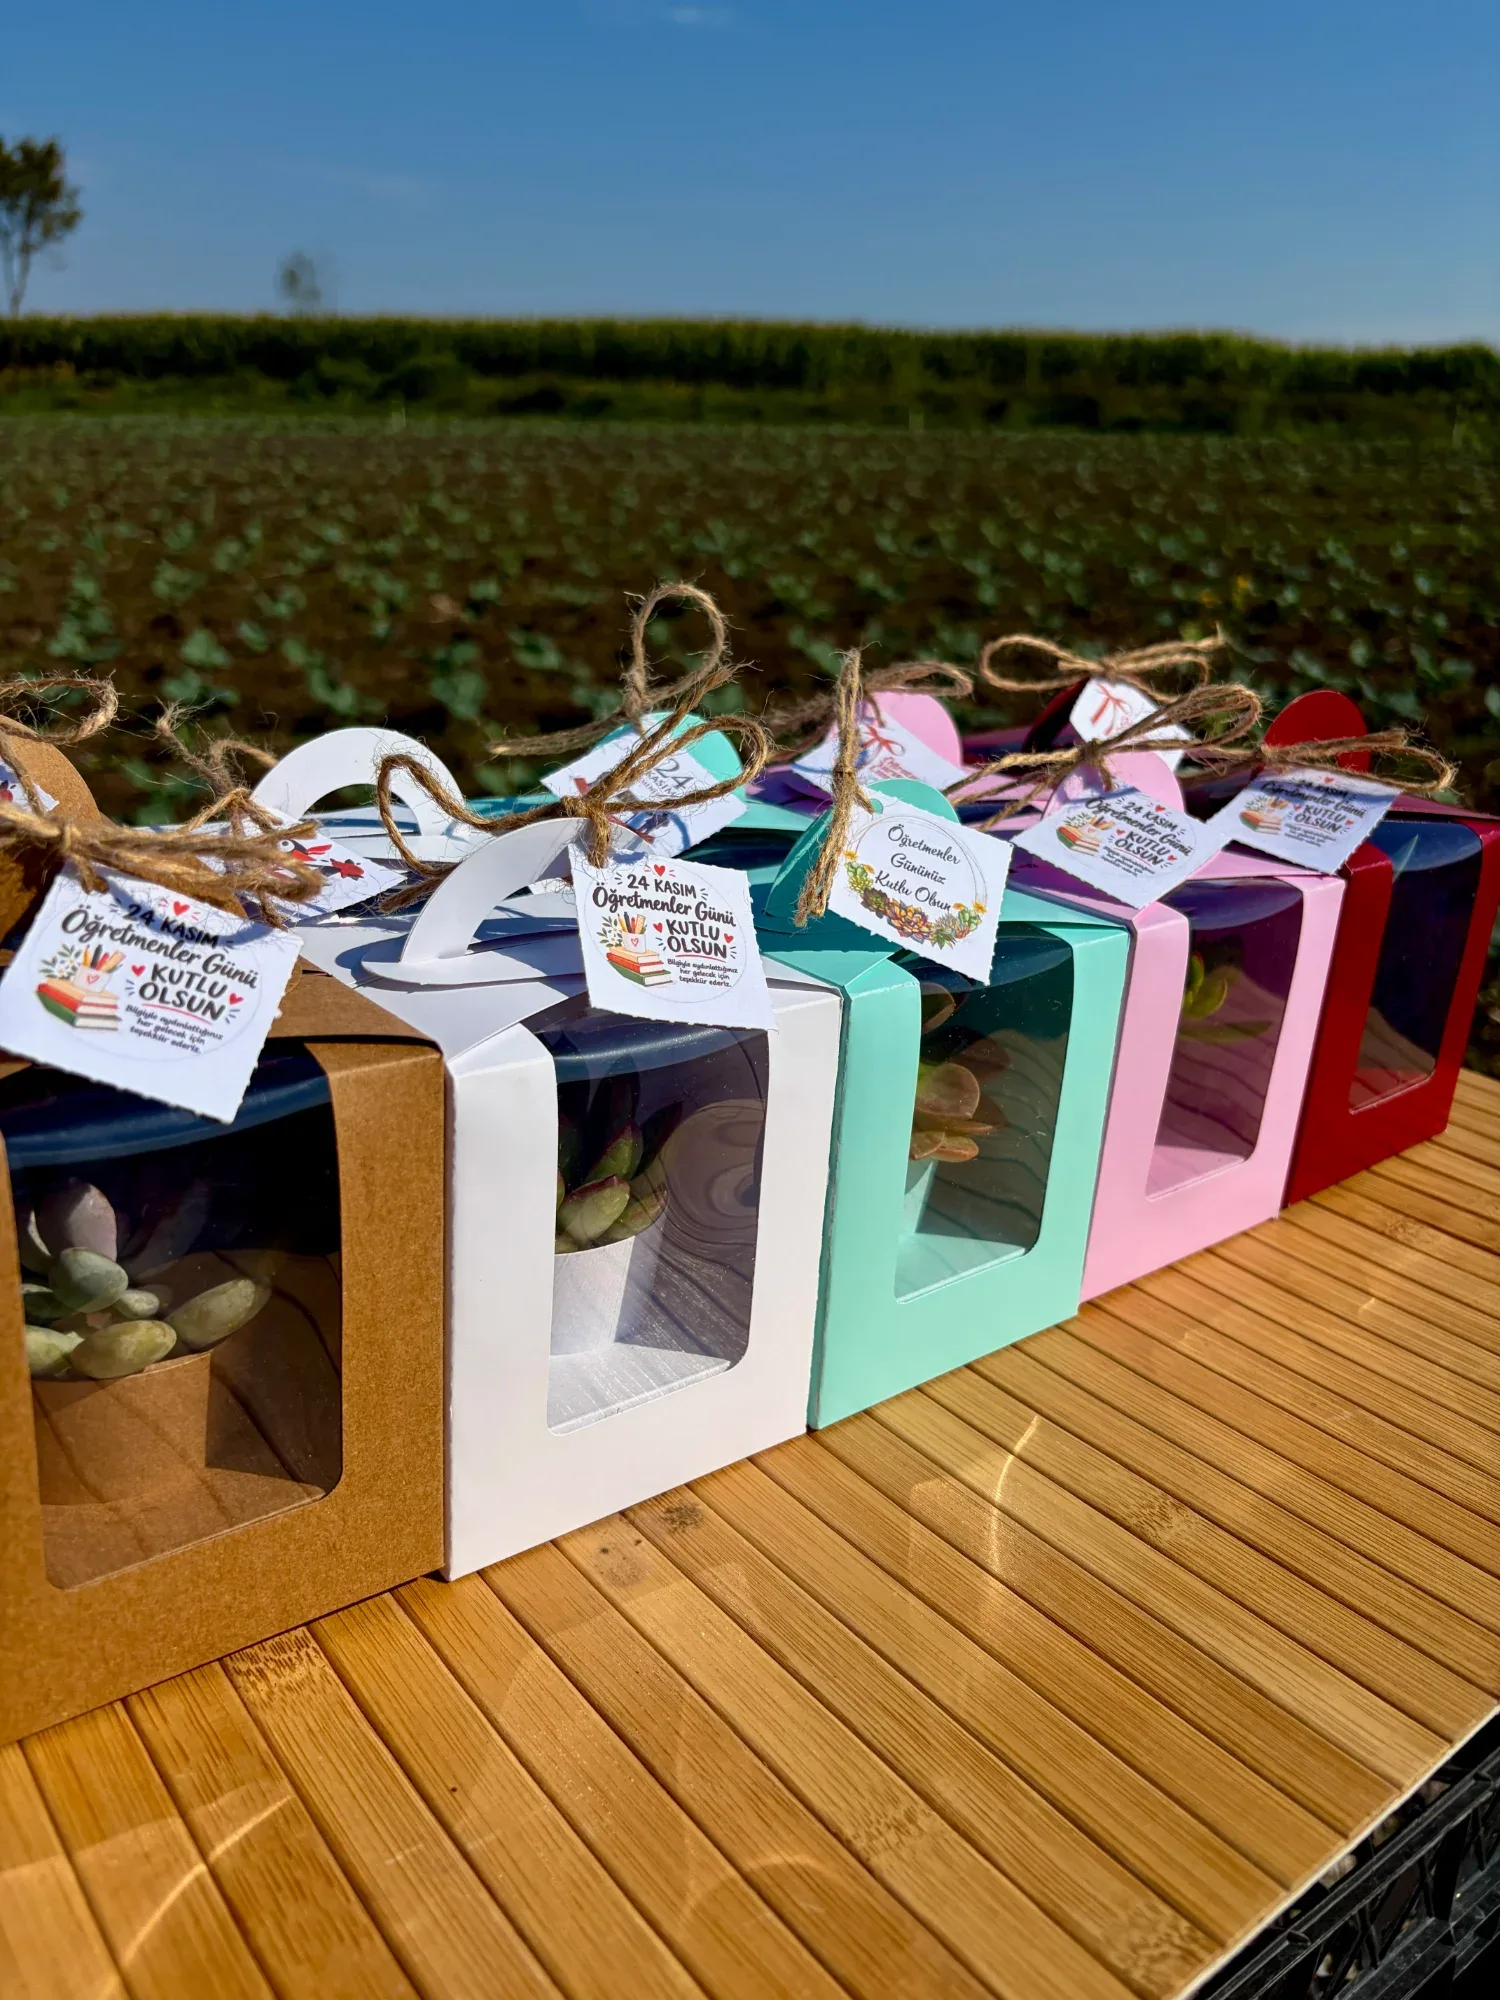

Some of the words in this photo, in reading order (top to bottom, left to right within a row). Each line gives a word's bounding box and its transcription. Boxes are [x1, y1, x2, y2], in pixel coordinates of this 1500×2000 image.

[654, 758, 694, 789] 24
[1122, 802, 1143, 814] 24
[1143, 811, 1178, 832] KASIM
[1294, 813, 1342, 833] OLSUN
[1303, 804, 1347, 823] KUTLU
[888, 824, 960, 865] Öğretmenler
[1115, 838, 1164, 865] OLSUN
[1125, 831, 1170, 855] KUTLU
[1159, 833, 1193, 856] Günü
[890, 853, 946, 885] Gününüz
[627, 874, 649, 890] 24
[655, 879, 697, 899] KASIM
[875, 870, 912, 896] Kutlu
[915, 887, 952, 912] Olsun
[592, 882, 692, 915] Öğretmenler
[695, 901, 736, 927] Günü
[122, 903, 155, 927] 24
[160, 917, 220, 948] KASIM
[666, 919, 720, 941] KUTLU
[61, 905, 201, 965] Öğretmenler
[202, 952, 258, 989] Günü
[667, 936, 727, 959] OLSUN
[151, 963, 229, 1000] KUTLU
[679, 976, 707, 984] teşekkür
[693, 970, 716, 978] gelecek
[718, 972, 730, 980] için
[139, 982, 226, 1021] OLSUN
[130, 1026, 169, 1043] teşekkür
[137, 1018, 153, 1027] her
[153, 1025, 187, 1039] gelecek
[189, 1034, 205, 1045] için
